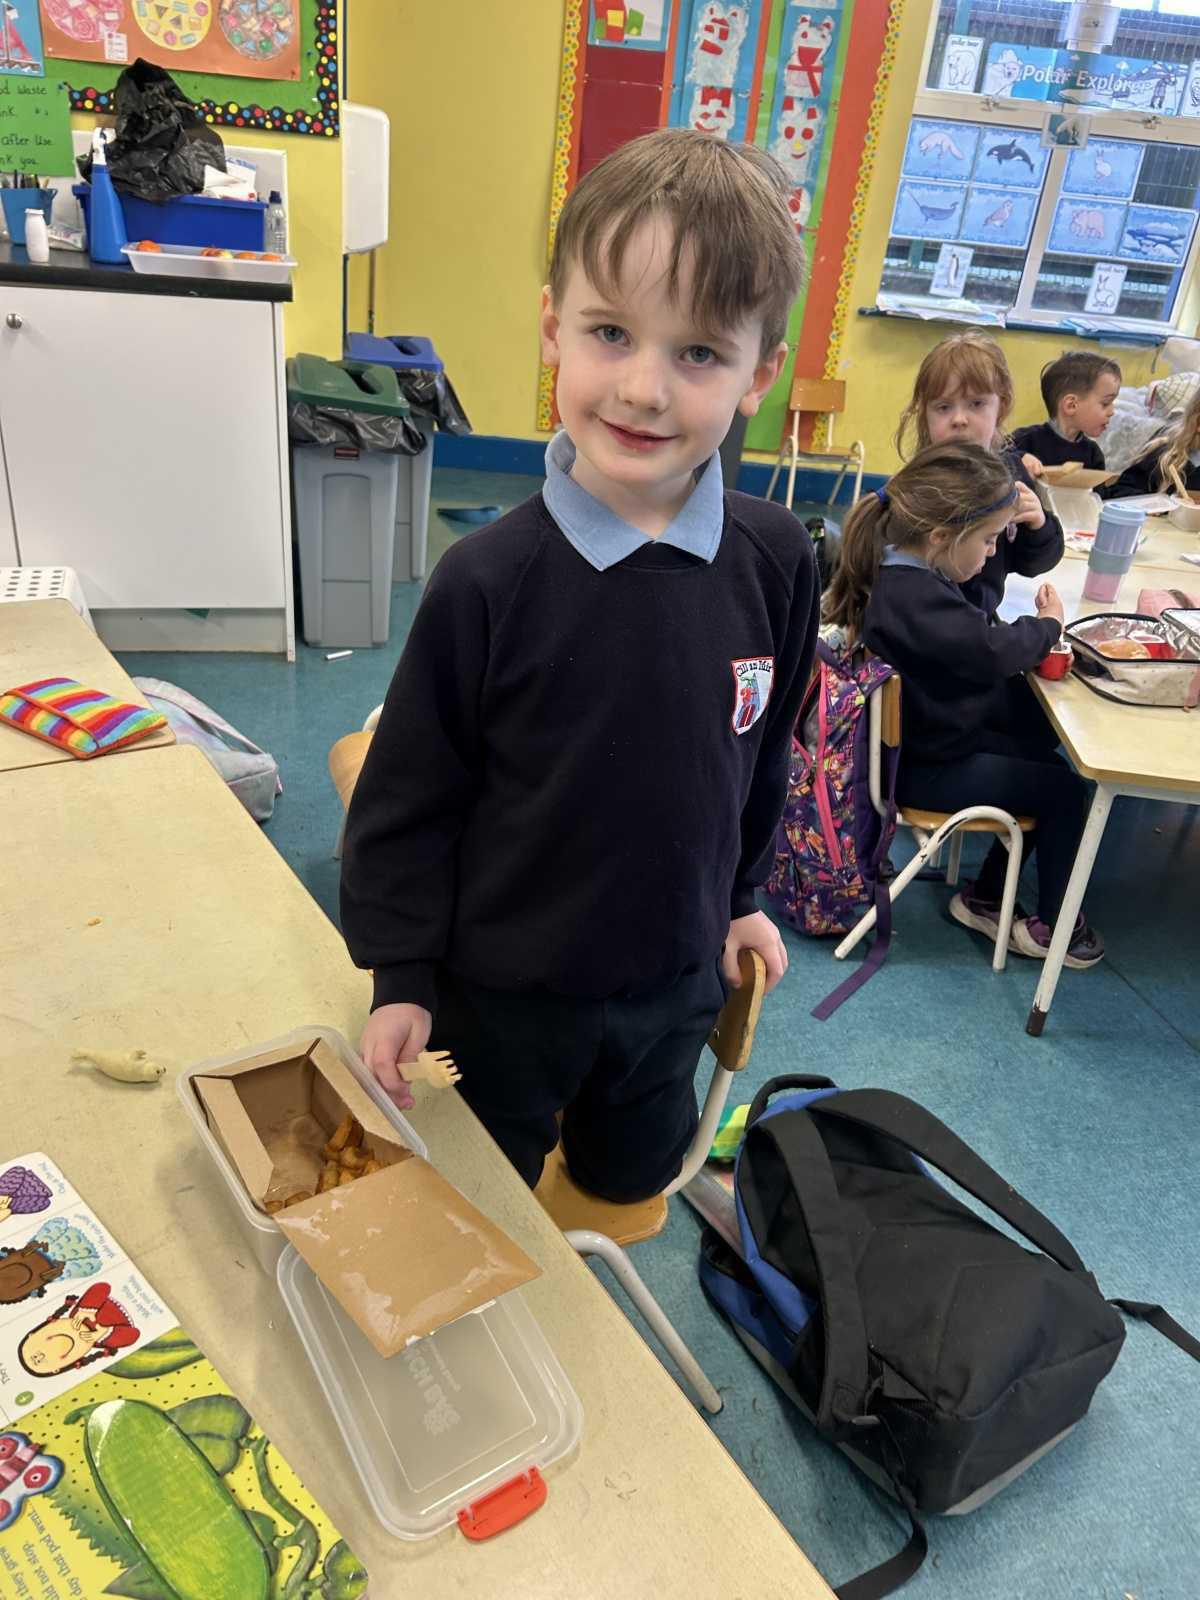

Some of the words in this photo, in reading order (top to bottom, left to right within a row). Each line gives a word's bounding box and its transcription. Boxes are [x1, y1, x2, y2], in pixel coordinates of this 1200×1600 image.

[1022, 65, 1072, 84] Polar
[0, 80, 10, 95] od
[0, 105, 15, 117] nk
[0, 155, 12, 166] nk
[736, 662, 749, 677] Cill
[40, 1534, 61, 1553] pod
[54, 1554, 71, 1577] that
[34, 1566, 49, 1585] not
[67, 1577, 82, 1596] day
